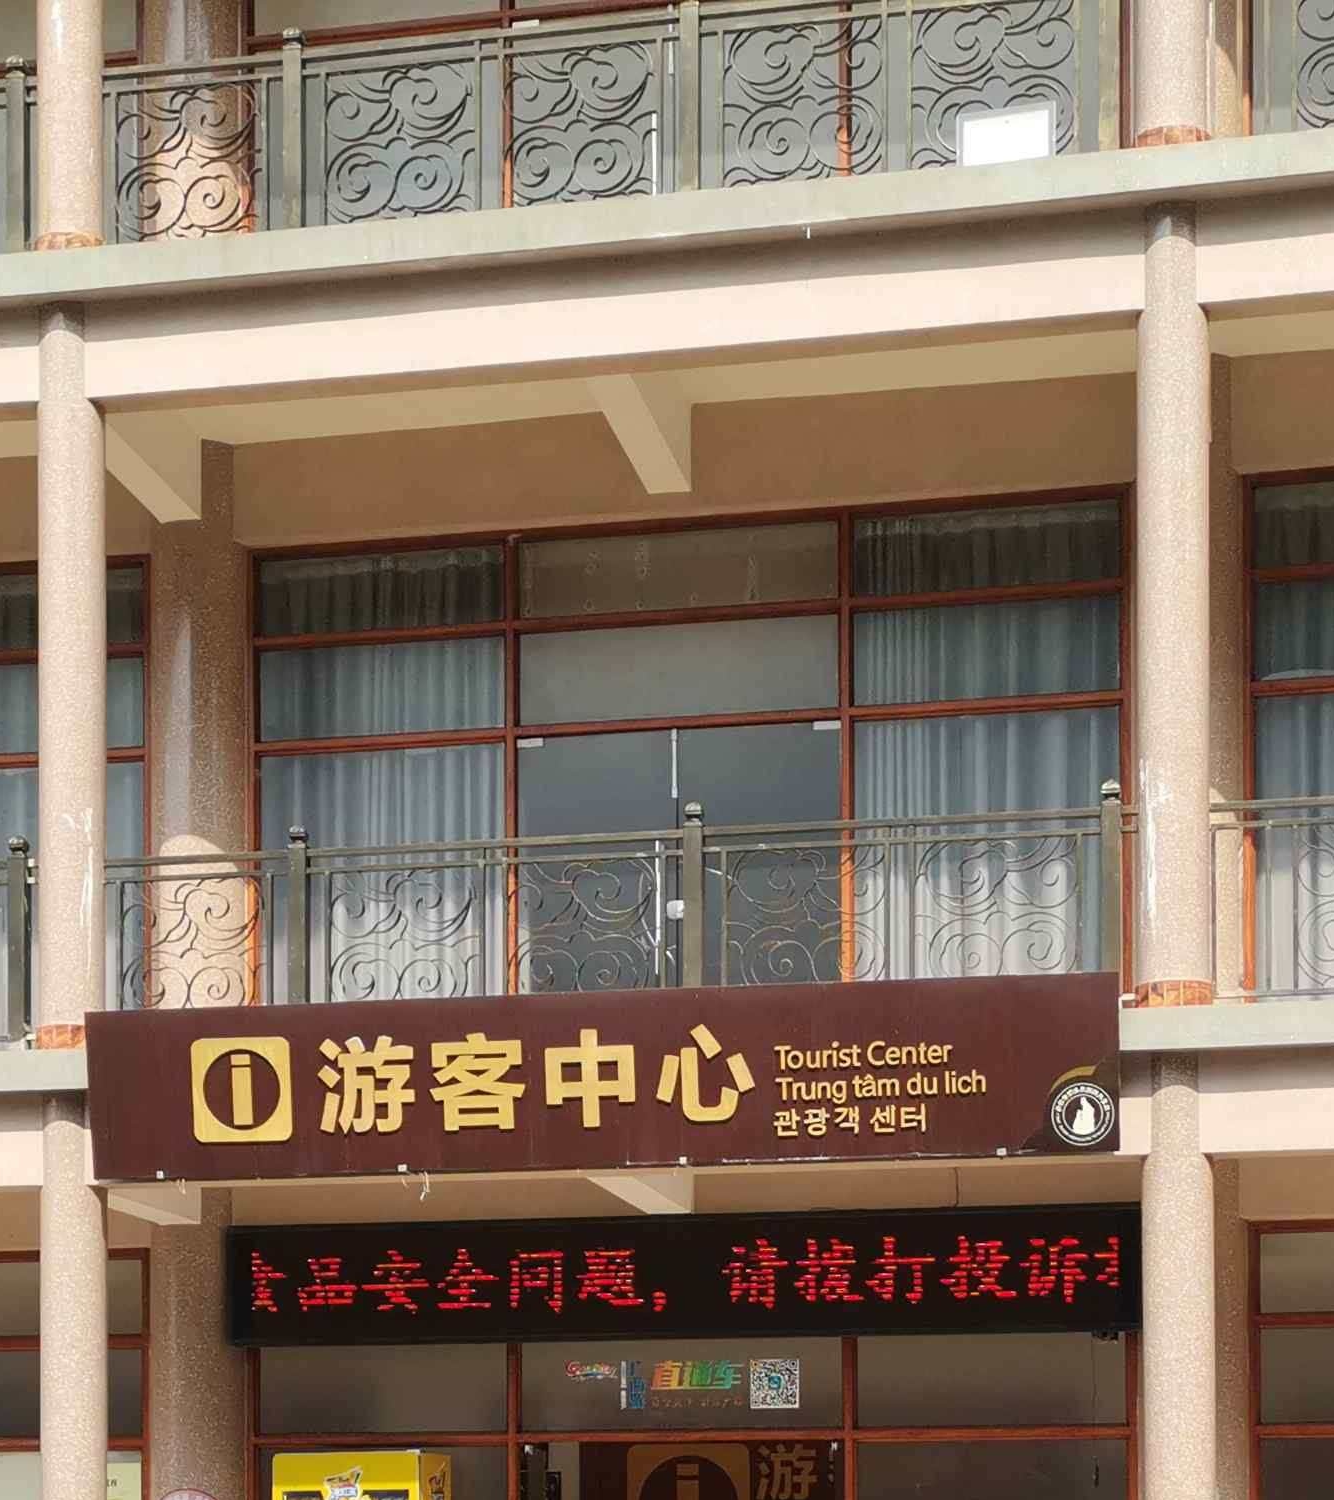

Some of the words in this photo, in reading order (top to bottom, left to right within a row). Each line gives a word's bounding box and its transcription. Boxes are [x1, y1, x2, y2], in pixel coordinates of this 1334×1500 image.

[774, 1041, 861, 1071] Tourist
[867, 1041, 953, 1067] Center
[317, 1023, 756, 1134] 游客中心
[775, 1077, 847, 1105] Trung
[852, 1074, 900, 1099] tâm
[906, 1072, 938, 1096] du
[944, 1069, 987, 1095] lich
[773, 1106, 860, 1137] 관광객
[870, 1104, 927, 1133] 센터
